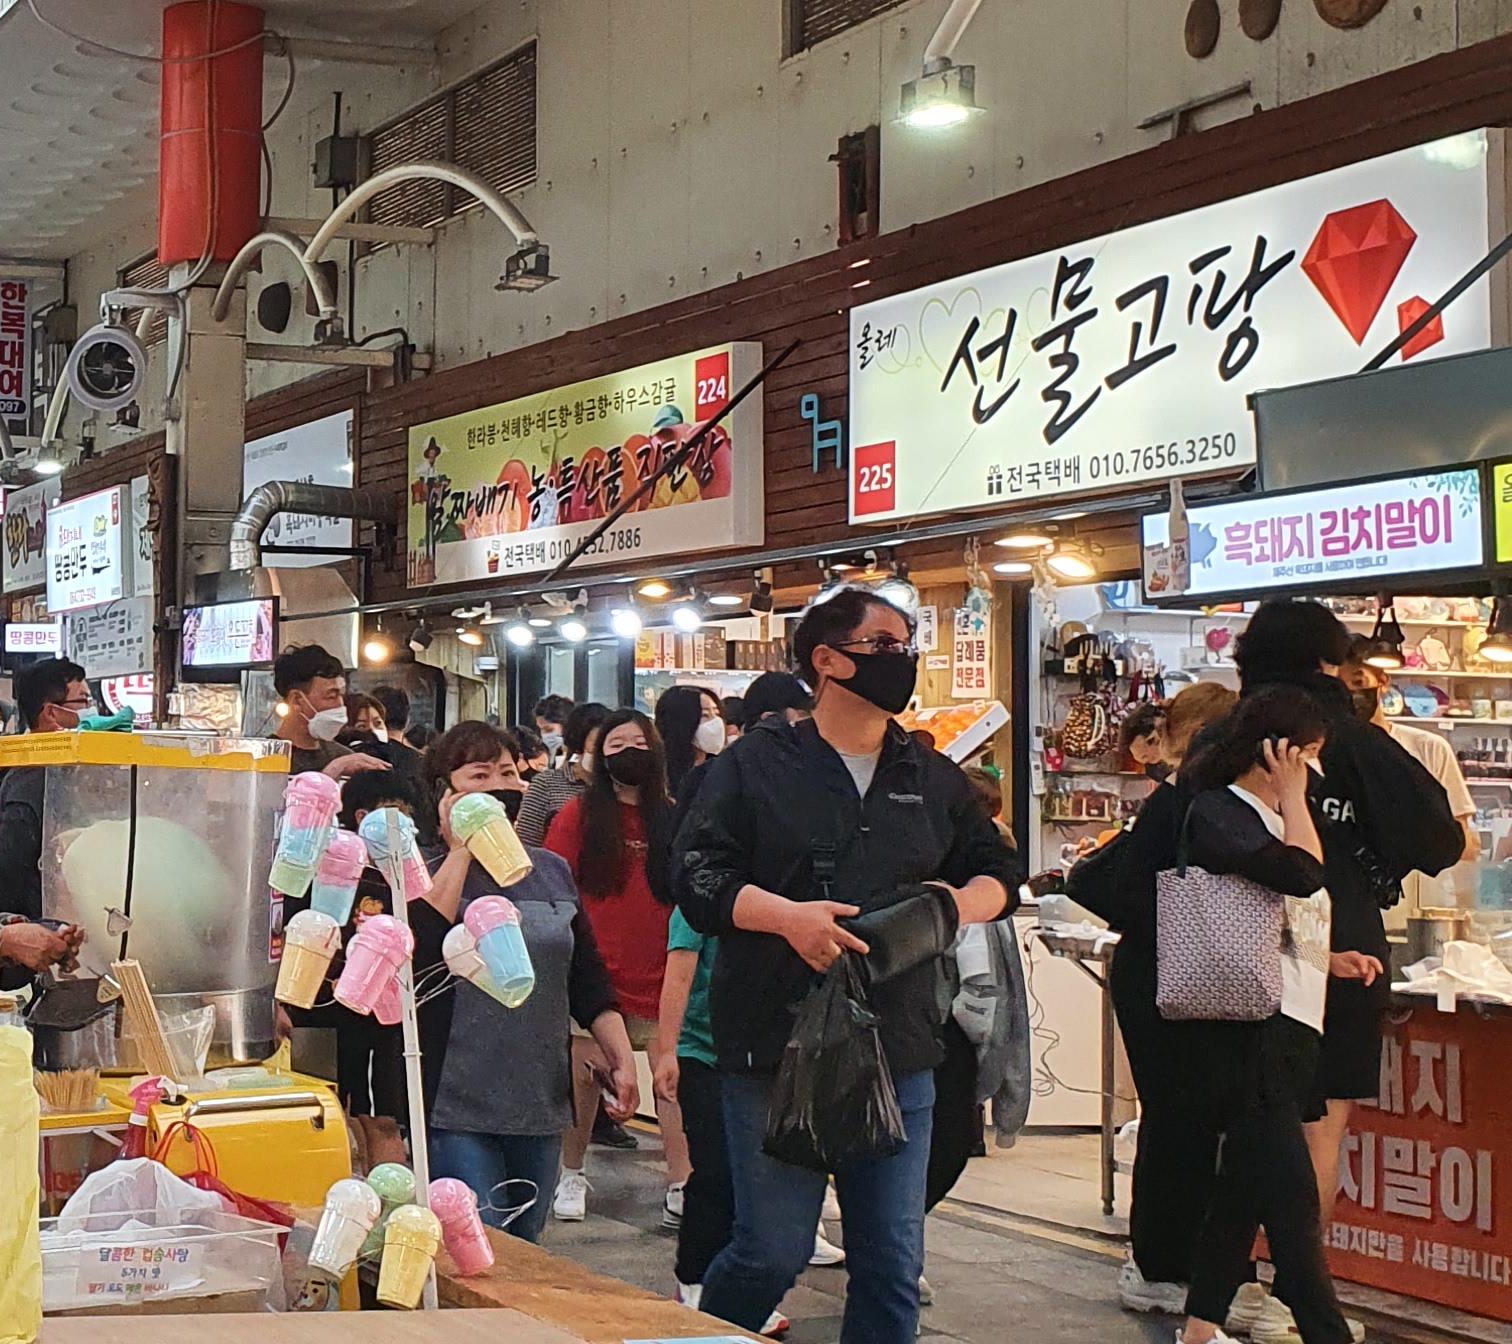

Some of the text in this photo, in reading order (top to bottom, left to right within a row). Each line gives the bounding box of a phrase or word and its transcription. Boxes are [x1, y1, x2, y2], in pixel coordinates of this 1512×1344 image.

[856, 321, 898, 371] 올레
[941, 235, 1296, 446] 선물고팡
[697, 375, 727, 405] 224
[1006, 432, 1236, 493] 전국택배 010.7656.3250
[859, 462, 892, 493] 225
[1224, 512, 1315, 566] 흑돼지
[1319, 494, 1453, 557] 김치말이
[504, 539, 546, 568] 전국택배
[10, 630, 58, 645] 땅콩만두
[956, 640, 986, 662] 답례품
[956, 667, 986, 688] 전문점
[99, 1247, 137, 1263] 달콤한
[120, 1267, 147, 1279] 5가지
